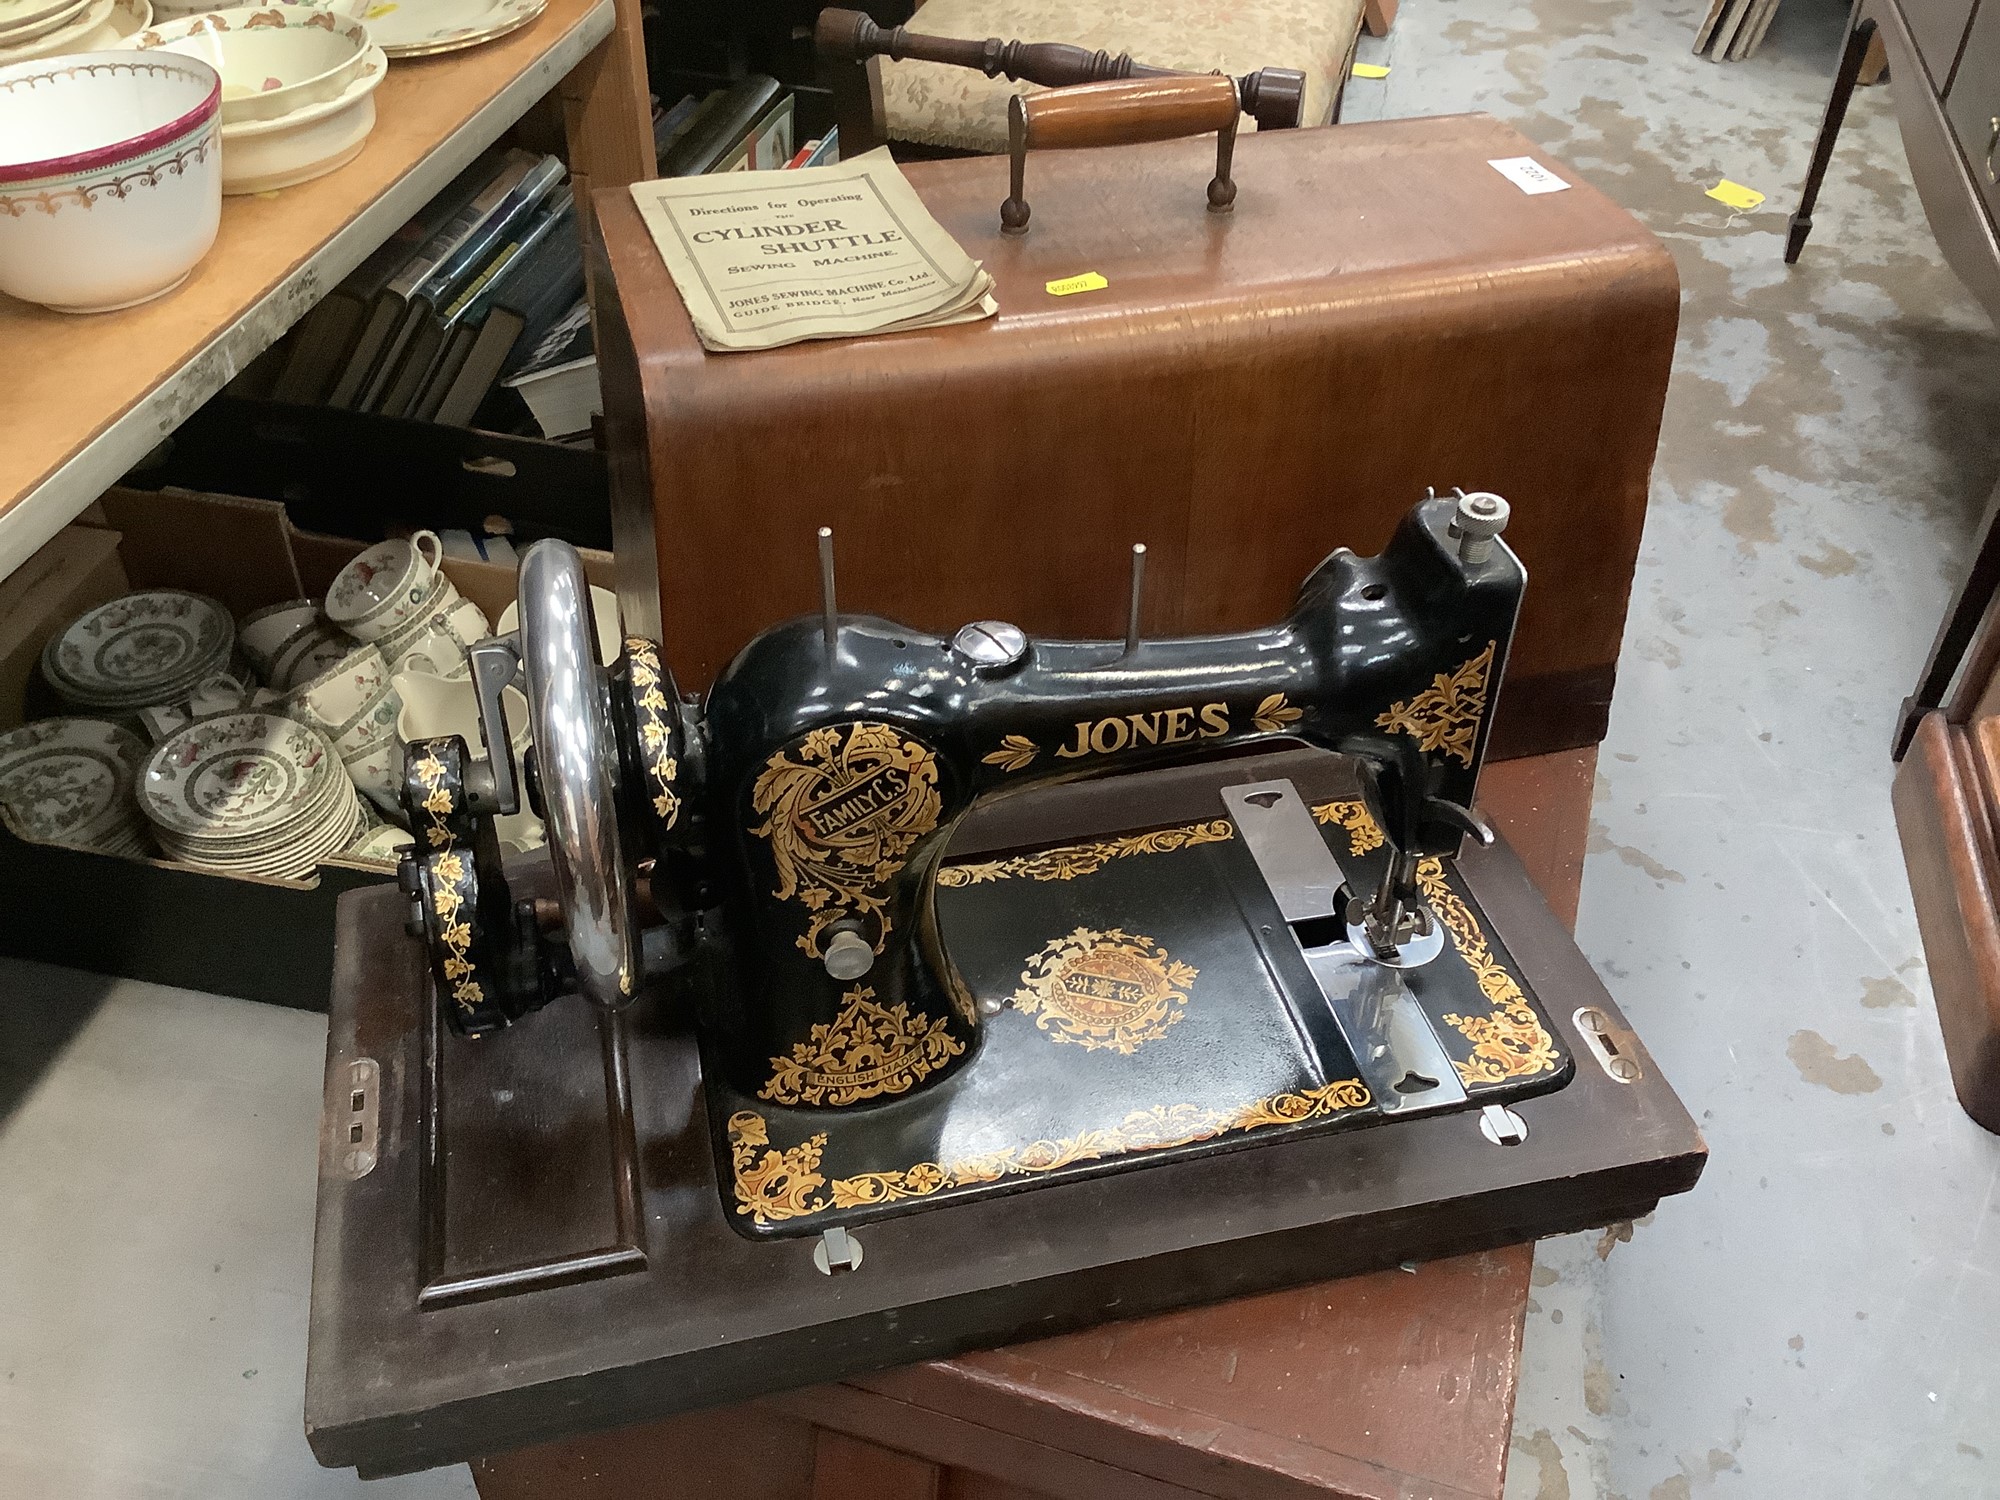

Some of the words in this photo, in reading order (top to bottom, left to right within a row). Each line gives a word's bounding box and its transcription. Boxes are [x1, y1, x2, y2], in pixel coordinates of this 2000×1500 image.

[689, 203, 759, 217] Directions
[767, 201, 788, 209] for
[797, 193, 863, 208] Operating
[692, 218, 848, 244] CYLINDER
[760, 230, 903, 255] SHUTTLE
[728, 294, 770, 309] JONES
[771, 289, 824, 301] SEWING
[826, 281, 887, 297] MACHINE
[888, 278, 908, 287] Co.
[909, 271, 933, 282] Ltd.
[733, 304, 780, 318] GUIDE
[852, 294, 876, 303] Near
[1054, 701, 1230, 758] JONES
[808, 787, 878, 835] FAMILY
[817, 1072, 875, 1085] ENGLISH
[881, 1053, 916, 1075] MADE
